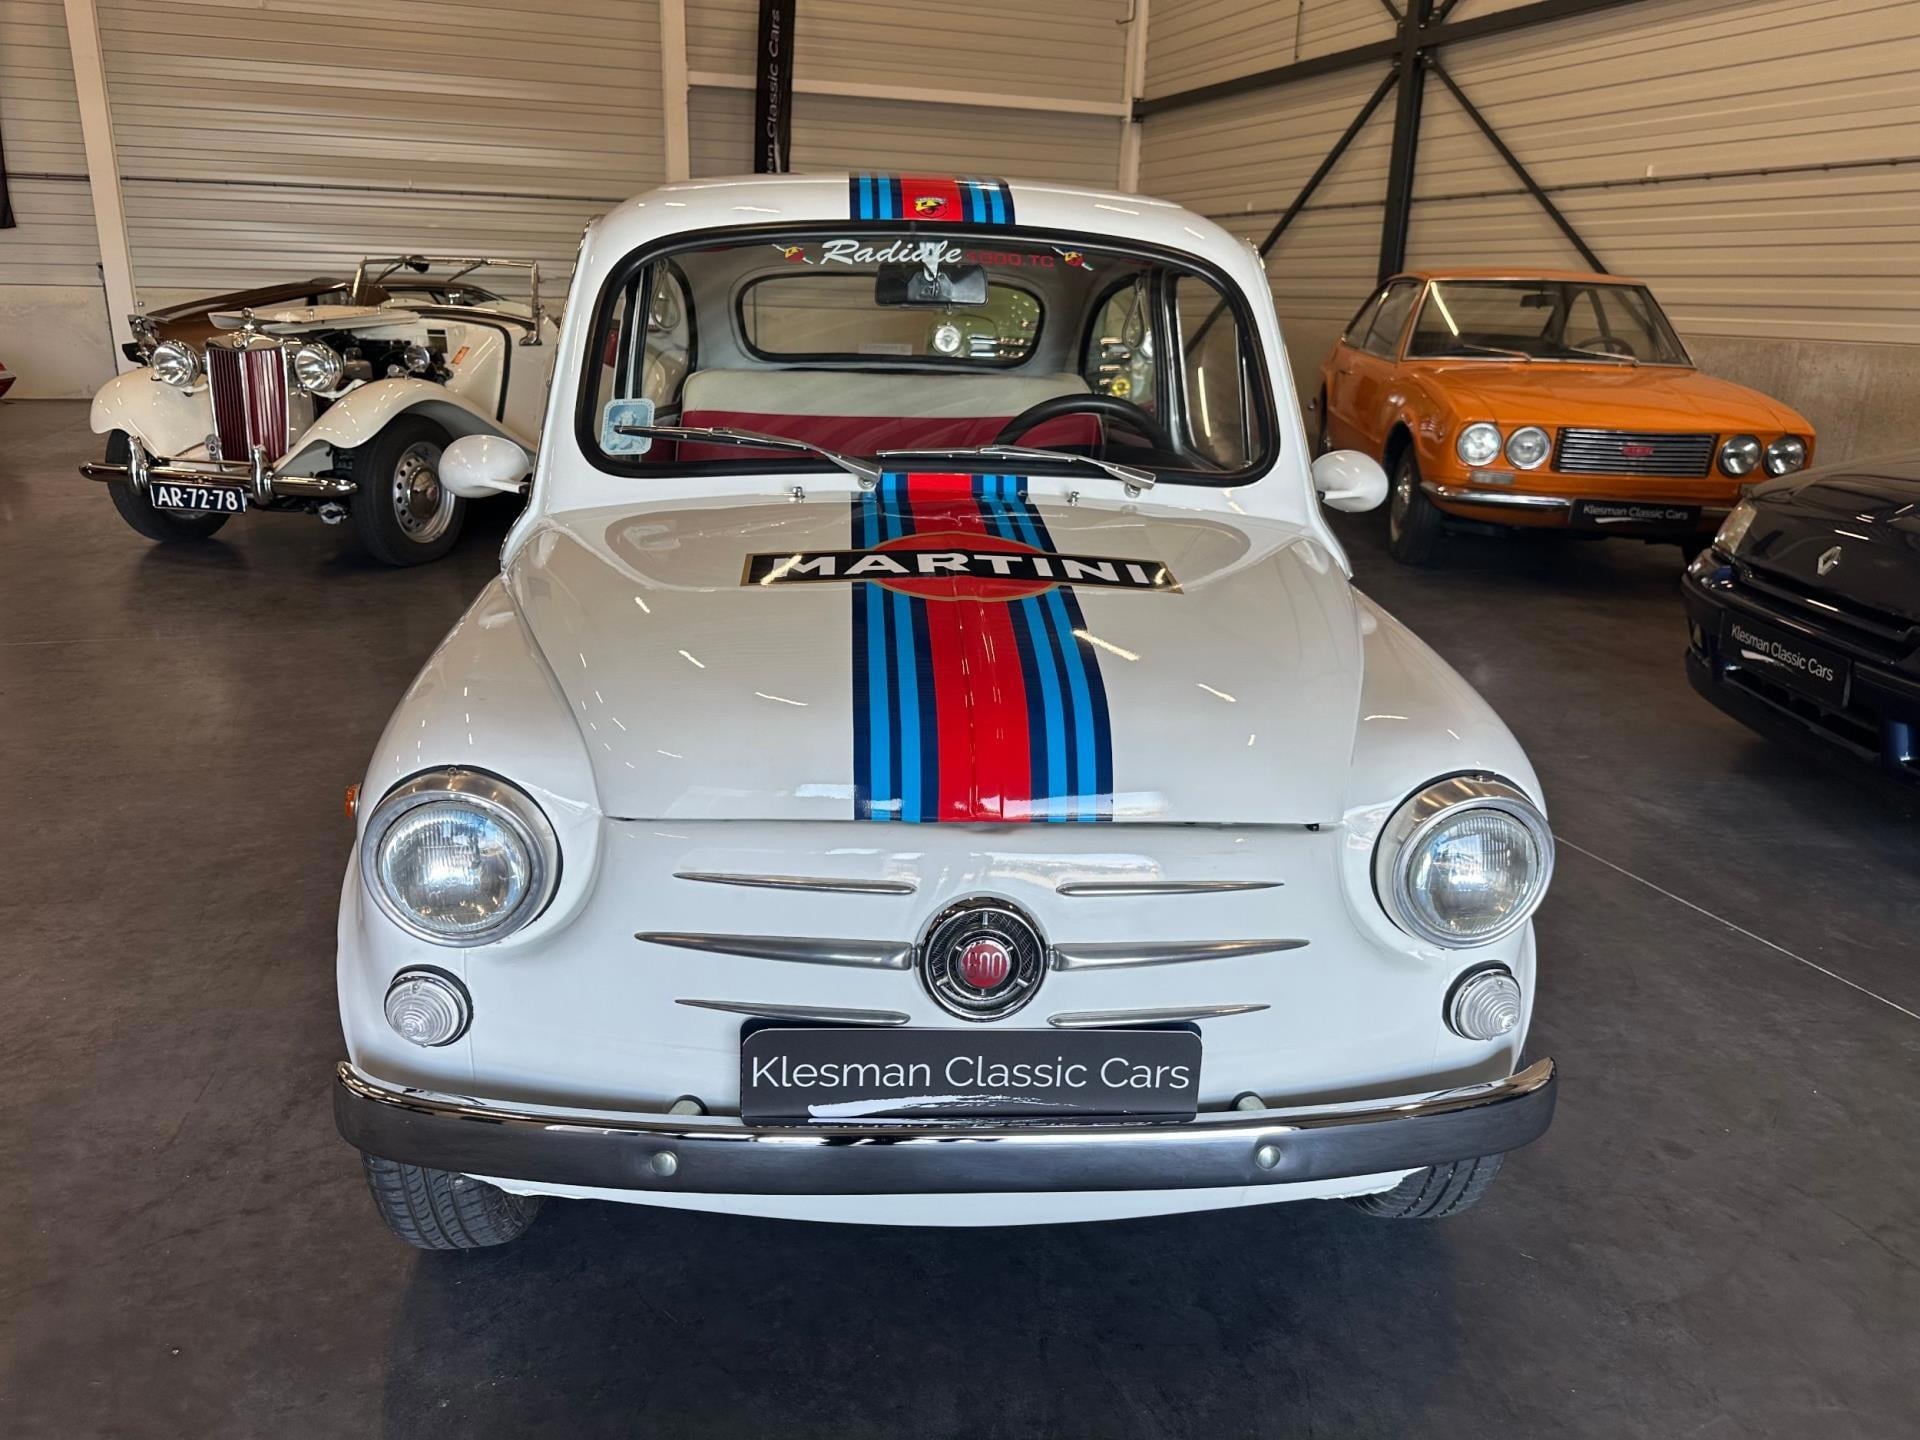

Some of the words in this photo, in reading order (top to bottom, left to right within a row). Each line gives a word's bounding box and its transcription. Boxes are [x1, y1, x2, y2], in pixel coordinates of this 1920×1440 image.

[768, 9, 781, 57] Cars
[767, 63, 780, 138] Classic
[158, 486, 238, 511] AR-72-78
[1628, 506, 1665, 519] Classic
[1665, 509, 1689, 520] Cars
[773, 552, 1151, 584] MARTINI
[1731, 624, 1770, 653] Klesman
[1771, 642, 1806, 669] Classic
[1808, 658, 1834, 681] Cars
[752, 1056, 932, 1088] Klesman
[945, 1056, 1088, 1088] Classic
[1100, 1057, 1190, 1089] Cars
